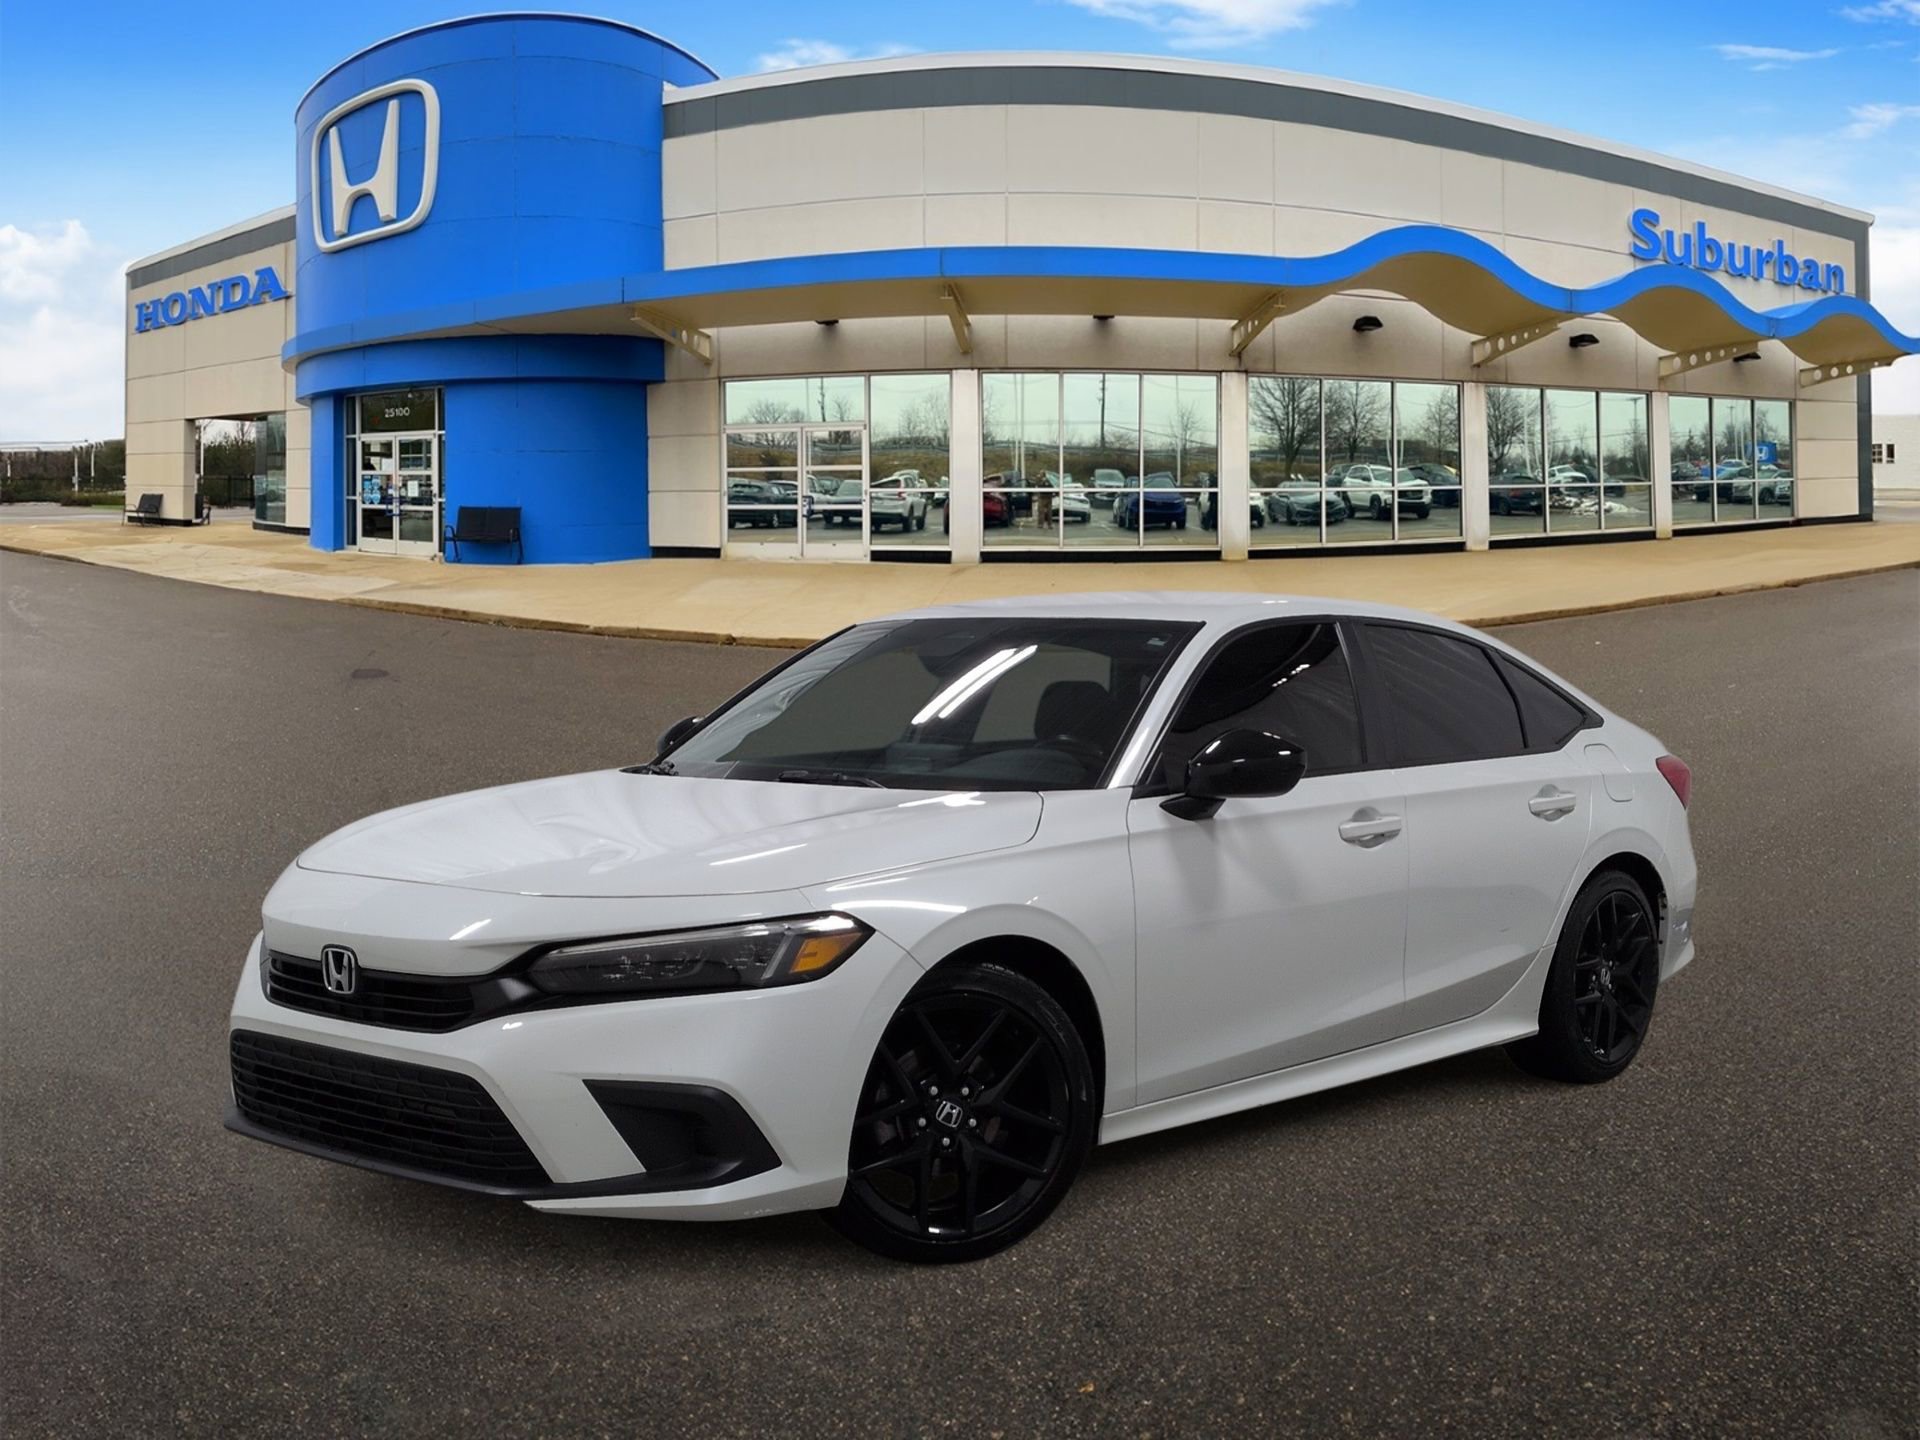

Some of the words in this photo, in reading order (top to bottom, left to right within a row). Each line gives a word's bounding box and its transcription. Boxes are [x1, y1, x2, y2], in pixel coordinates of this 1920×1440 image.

[1630, 208, 1845, 294] Suburban
[135, 265, 292, 333] HONDA
[384, 407, 410, 418] 25100
